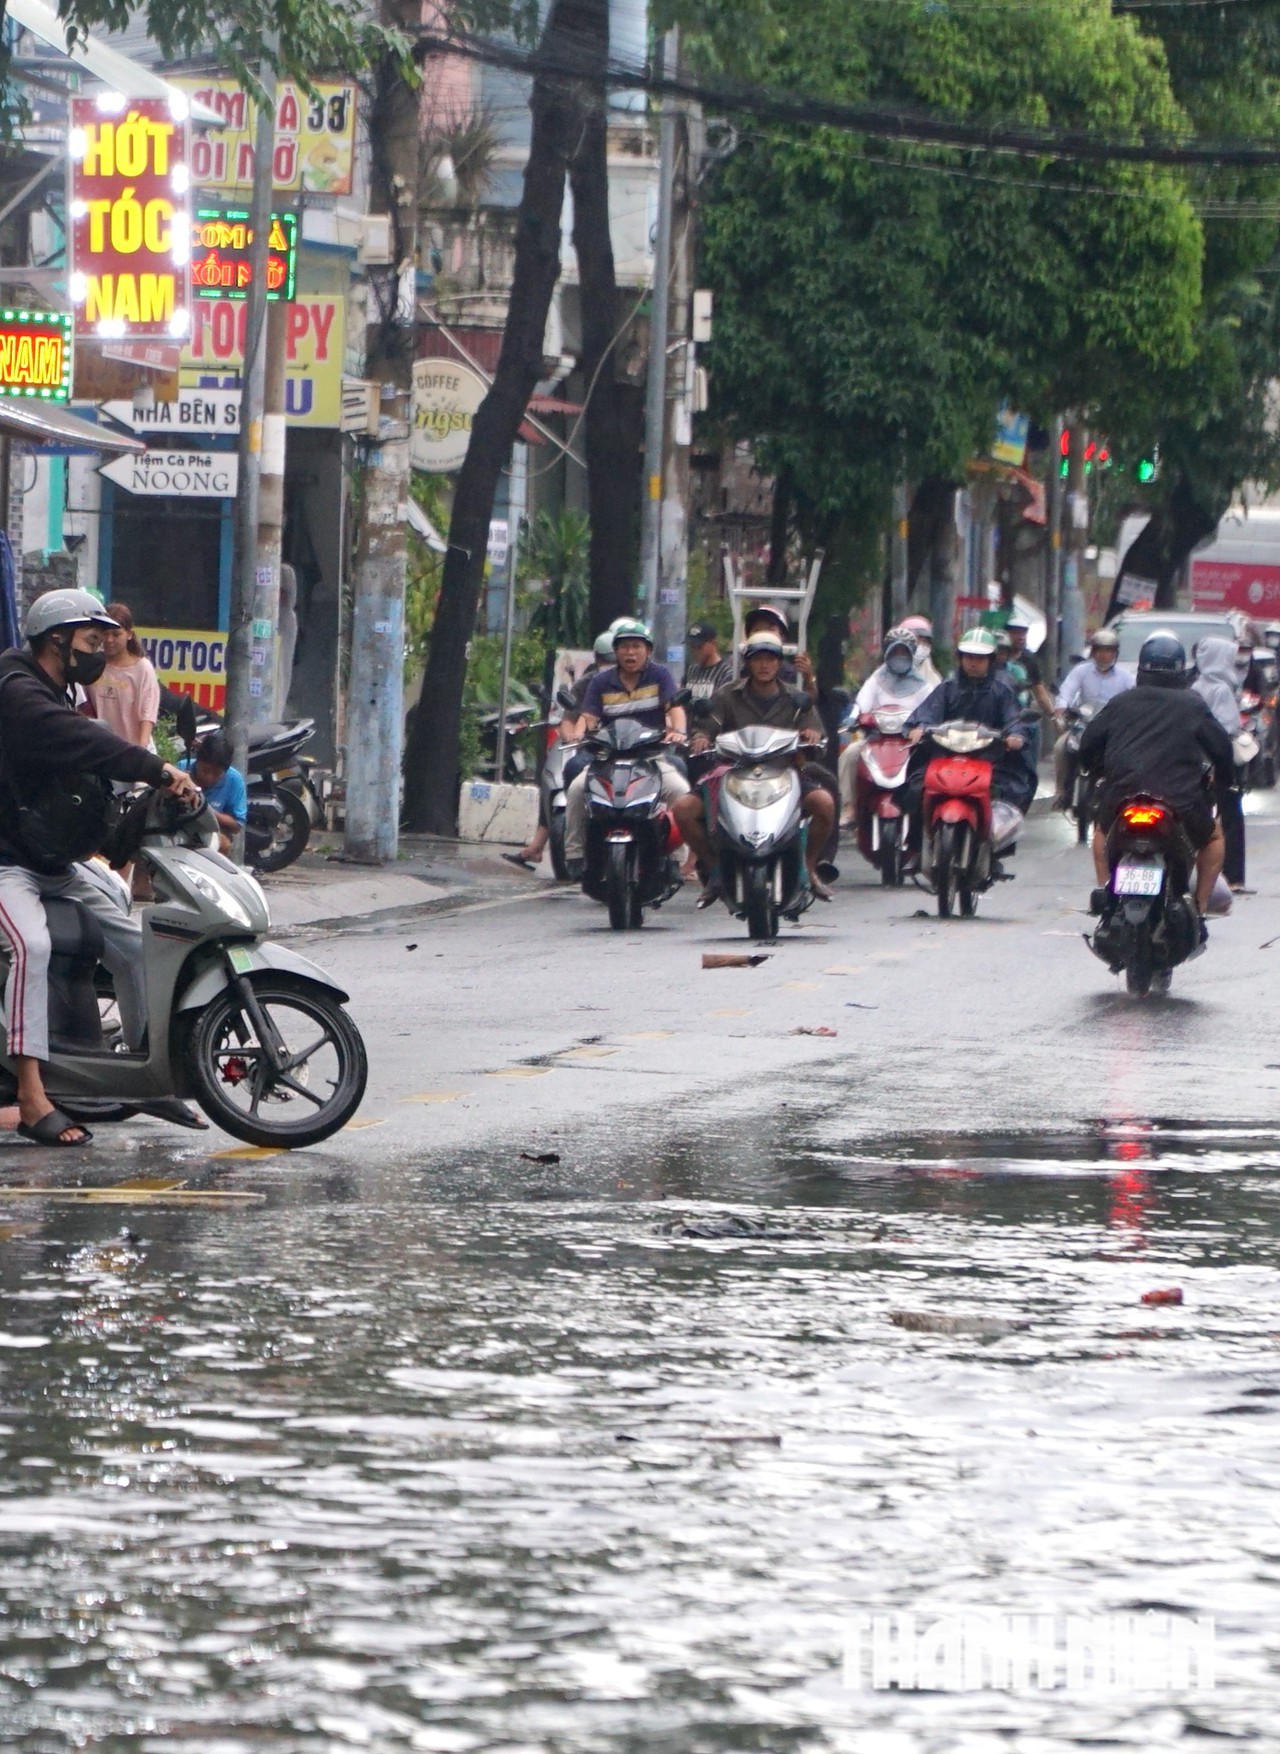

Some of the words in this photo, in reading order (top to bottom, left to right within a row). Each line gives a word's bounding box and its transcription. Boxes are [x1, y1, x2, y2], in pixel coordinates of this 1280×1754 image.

[83, 110, 175, 177] HỚT
[86, 187, 175, 254] TÓC
[86, 273, 175, 323] NAM
[416, 375, 461, 393] COFFEE
[179, 399, 217, 425] BÊN
[134, 454, 164, 469] Tiệm
[167, 454, 185, 467] Cà
[188, 454, 212, 467] Phê
[131, 469, 229, 492] NOONG
